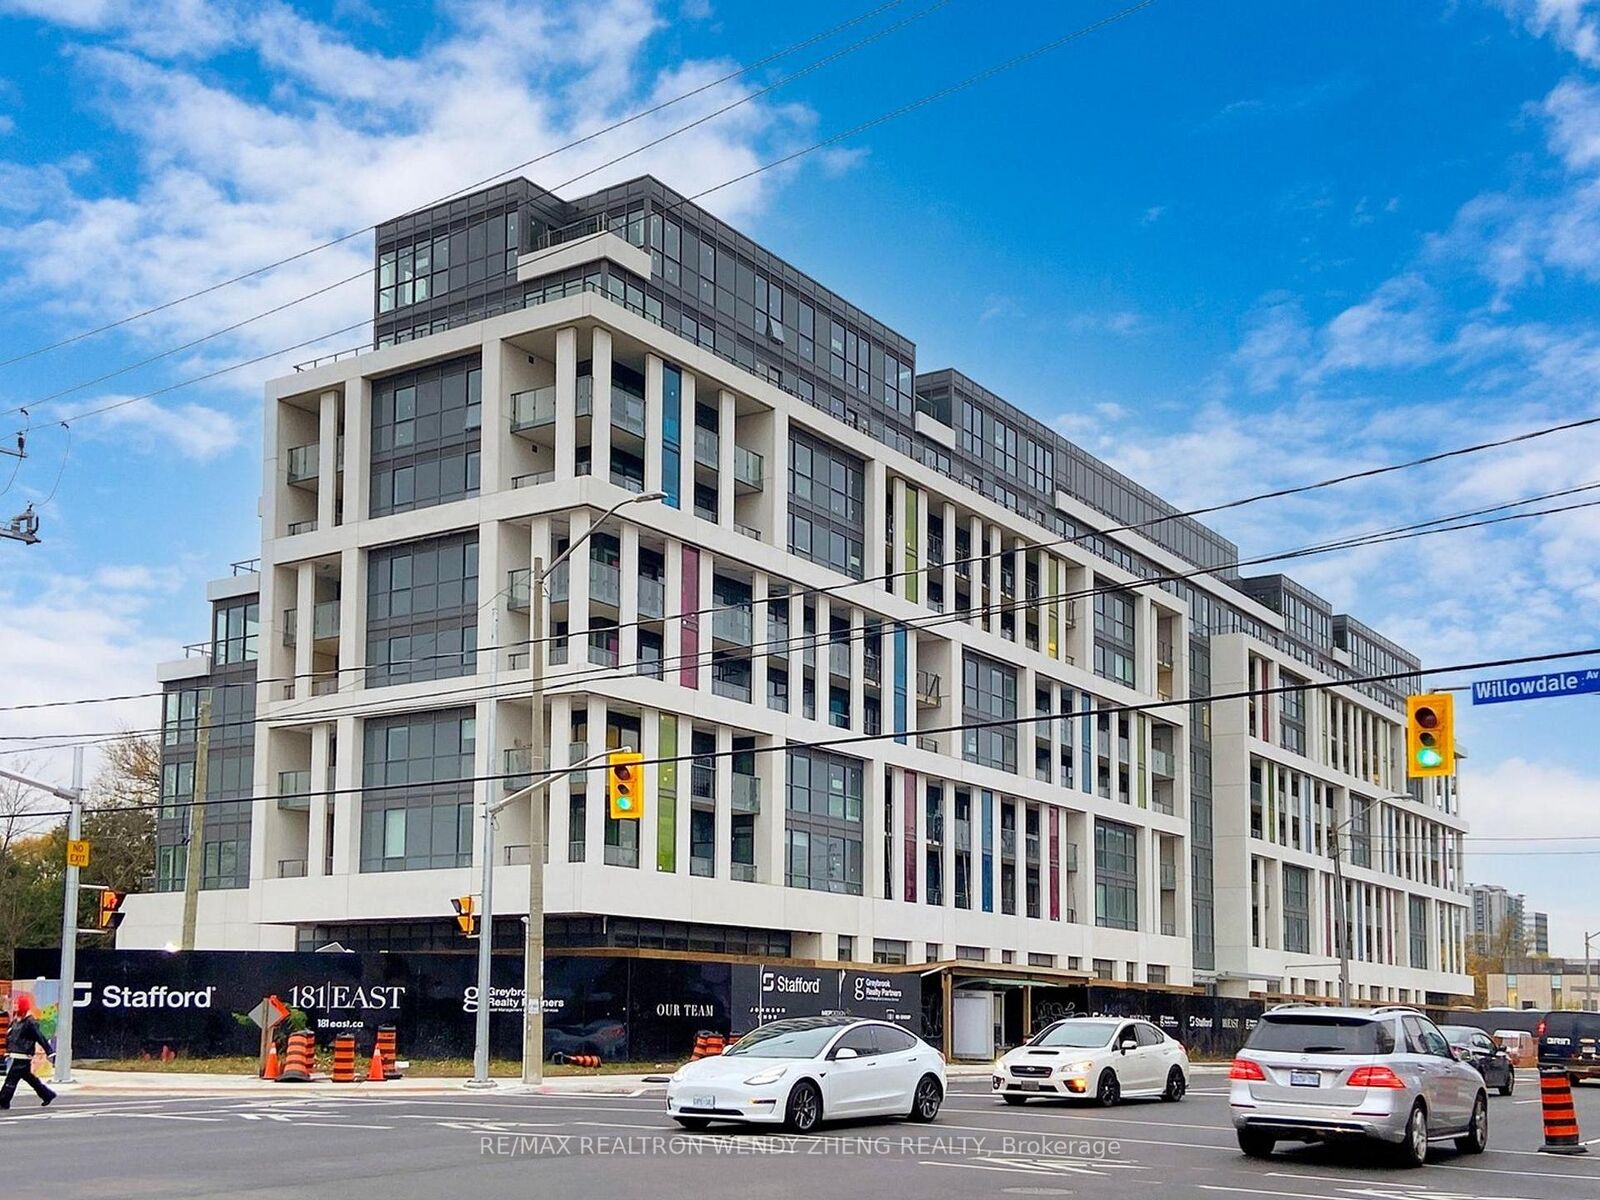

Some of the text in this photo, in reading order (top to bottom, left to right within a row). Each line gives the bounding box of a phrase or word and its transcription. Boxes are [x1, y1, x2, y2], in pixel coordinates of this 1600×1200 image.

[1476, 674, 1579, 699] Willowdale
[73, 844, 84, 853] NO
[70, 854, 85, 862] EXIT
[777, 975, 820, 993] Stafford
[101, 986, 212, 1008] Stafford
[656, 1003, 714, 1017] OUR TEAM
